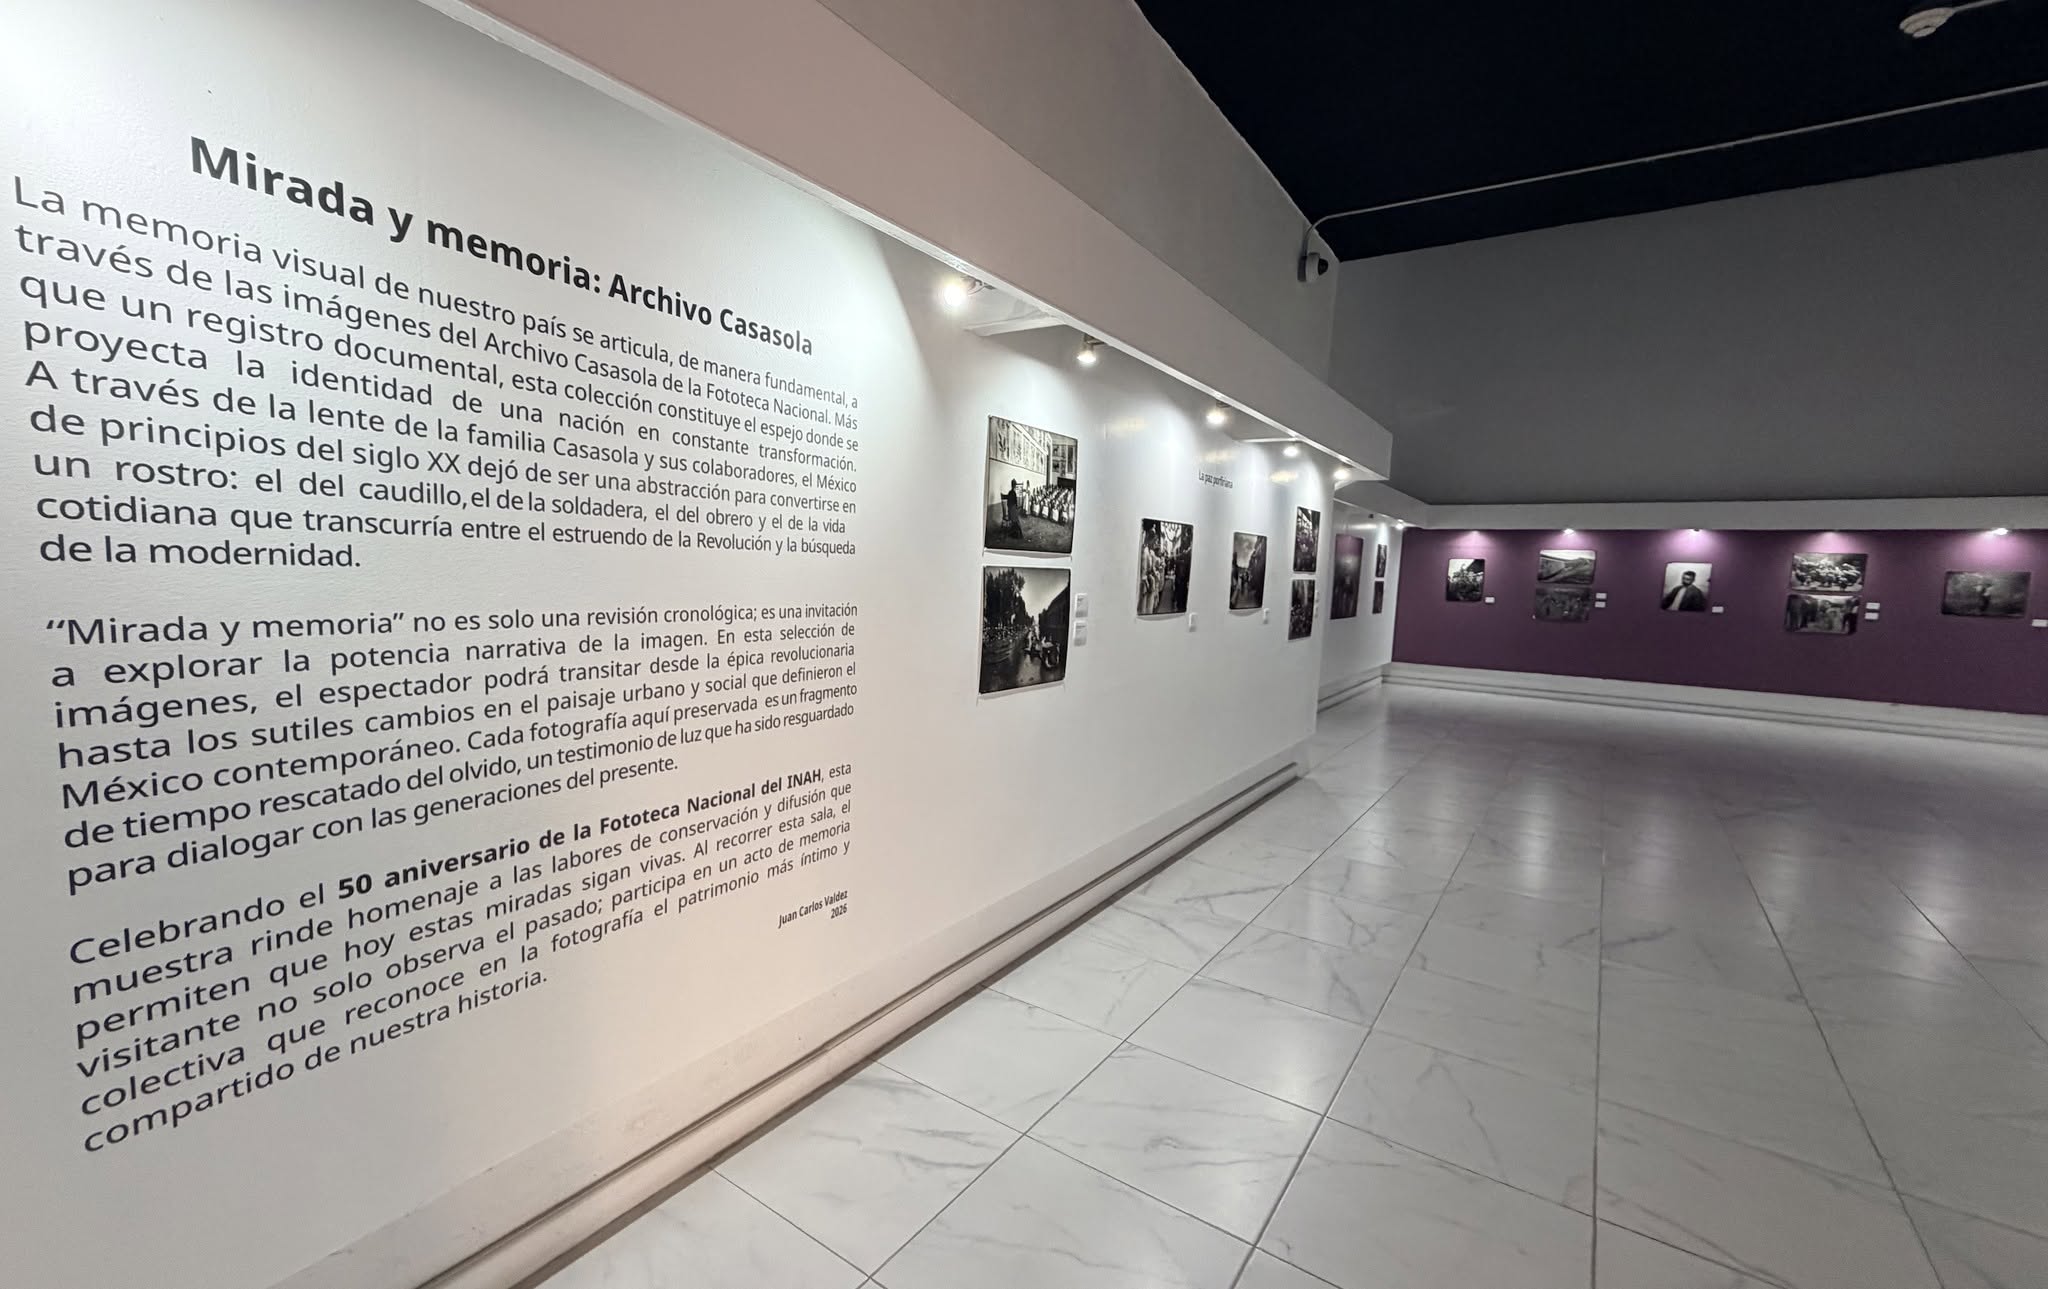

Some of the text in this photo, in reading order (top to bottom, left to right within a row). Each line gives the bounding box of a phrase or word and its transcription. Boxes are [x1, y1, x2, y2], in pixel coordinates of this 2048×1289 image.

[15, 176, 857, 408] La memoria visual de nuestro país se articula, de manera fundamental, a
[191, 136, 812, 355] Mirada y memoria: Archivo Casasola
[14, 225, 857, 429] través de las imágenes del Archivo Casasola de la Fototeca Nacional. Más
[24, 321, 856, 472] proyecta la identidad de una nación en constante transformación.
[30, 404, 856, 513] de principios del siglo XX dejó de ser una abstracción para convertirse en
[37, 495, 855, 557] cotidiana que transcurría entre el estruendo de la Revolución y la búsqueda
[1199, 470, 1204, 480] La
[40, 534, 360, 567] de la modernidad.
[55, 643, 854, 728] imágenes, el espectador podrá transitar desde la épica revolucionaria
[220, 621, 240, 647] y
[414, 616, 446, 632] no
[455, 615, 480, 630] es
[488, 609, 534, 629] solo
[542, 612, 580, 627] una
[588, 606, 658, 626] revisión
[761, 608, 775, 619] es
[779, 607, 802, 619] una
[805, 602, 857, 618] invitación
[63, 684, 857, 809] México contemporáneo. Cada fotografía aquí preservada es un fragmento
[69, 758, 678, 896] para dialogar con las generaciones del presente.
[70, 764, 851, 964] Celebrando el 50 aniversario de la Fototeca Nacional del INAH, esta
[76, 1014, 240, 1078] visitante
[258, 996, 297, 1022] no
[313, 971, 372, 1004] solo
[386, 936, 484, 979] observa
[496, 921, 514, 943] el
[612, 874, 685, 912] participa
[693, 866, 711, 880] en
[719, 858, 737, 872] un
[744, 847, 772, 865] acto
[778, 838, 794, 853] de
[800, 822, 850, 847] memoria
[778, 891, 848, 929] Juan Carlos Valdez
[831, 903, 847, 919] 2026
[82, 841, 850, 1115] colectiva que reconoce en la fotografía el patrimonio más íntimo y
[84, 971, 547, 1152] compartido de nuestra historia.
